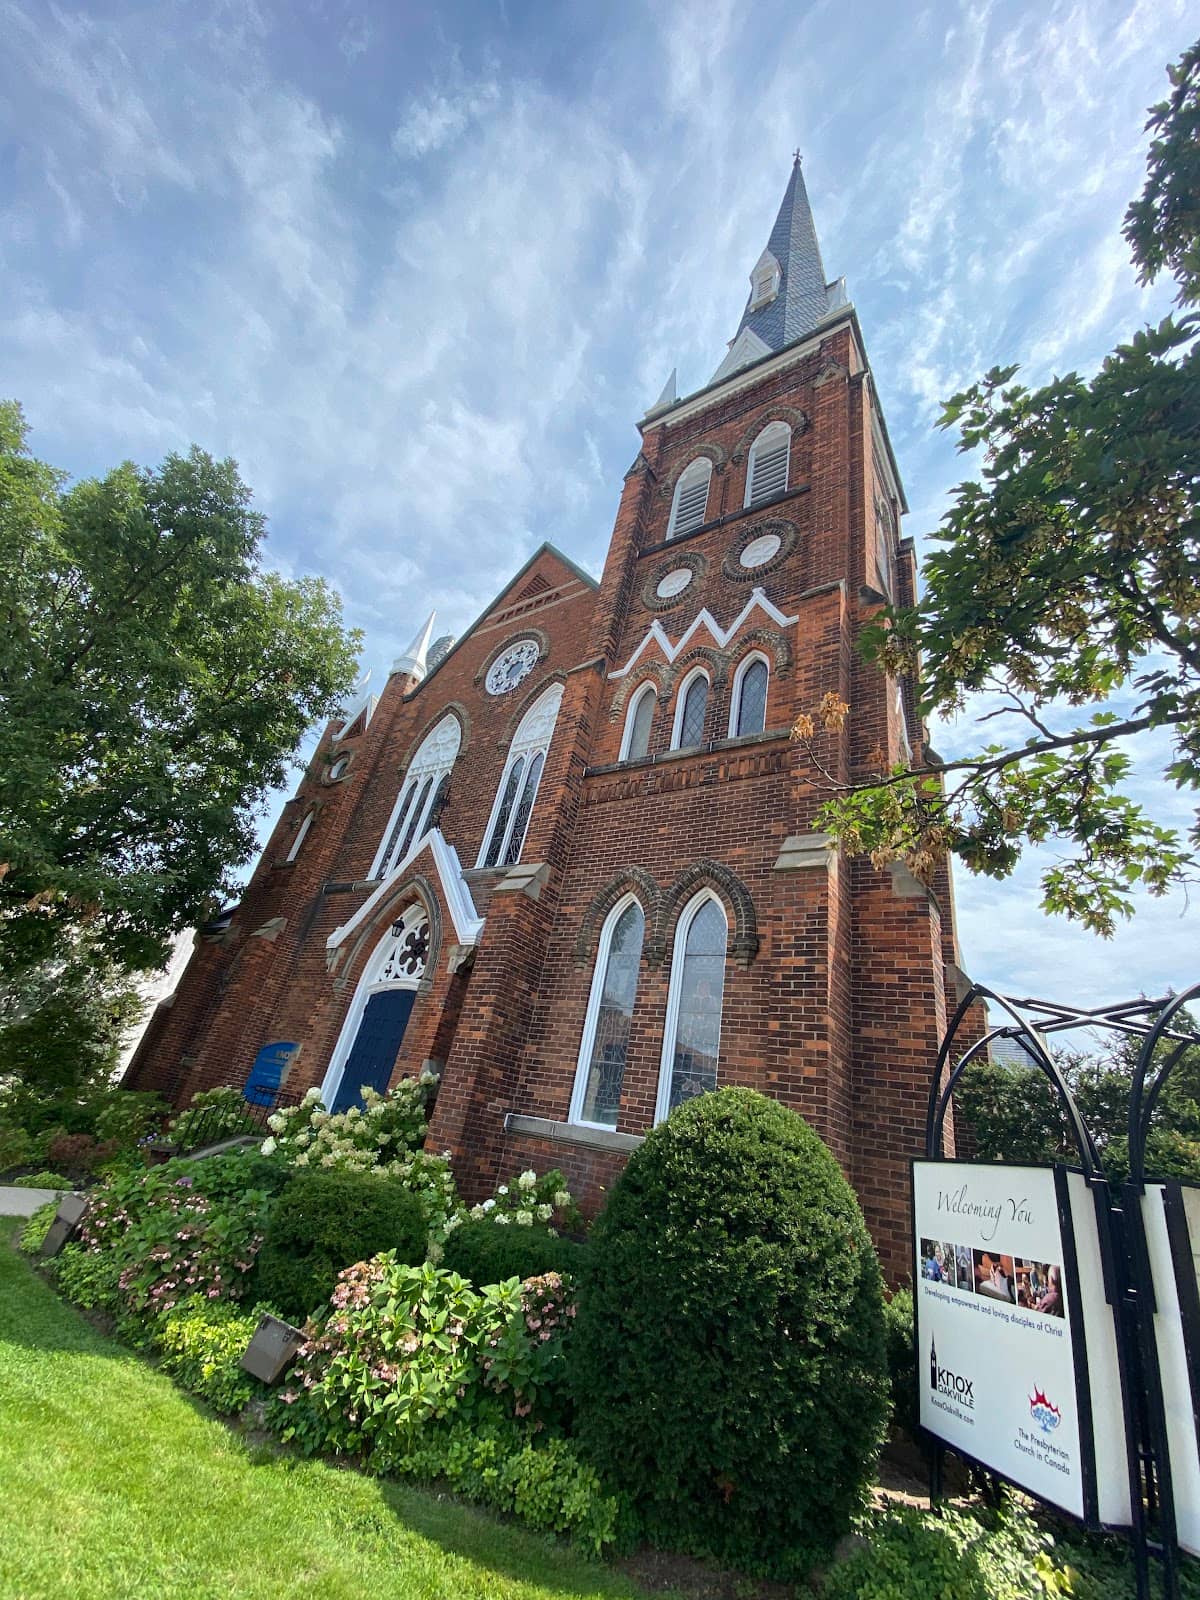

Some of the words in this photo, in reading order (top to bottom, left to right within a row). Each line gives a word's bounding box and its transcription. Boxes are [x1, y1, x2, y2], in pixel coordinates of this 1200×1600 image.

[937, 1184, 1002, 1241] Welcoming
[1007, 1198, 1034, 1224] You
[981, 1304, 992, 1315] and
[992, 1307, 1010, 1323] loving
[1010, 1313, 1036, 1328] disciples
[1036, 1321, 1043, 1331] of
[1044, 1323, 1063, 1337] Christ
[937, 1384, 975, 1410] OAKVILLE
[1014, 1439, 1035, 1457] Church
[1036, 1449, 1043, 1461] in
[1044, 1454, 1070, 1475] Canada
[1018, 1427, 1029, 1441] The
[1030, 1433, 1070, 1461] Presbyterian
